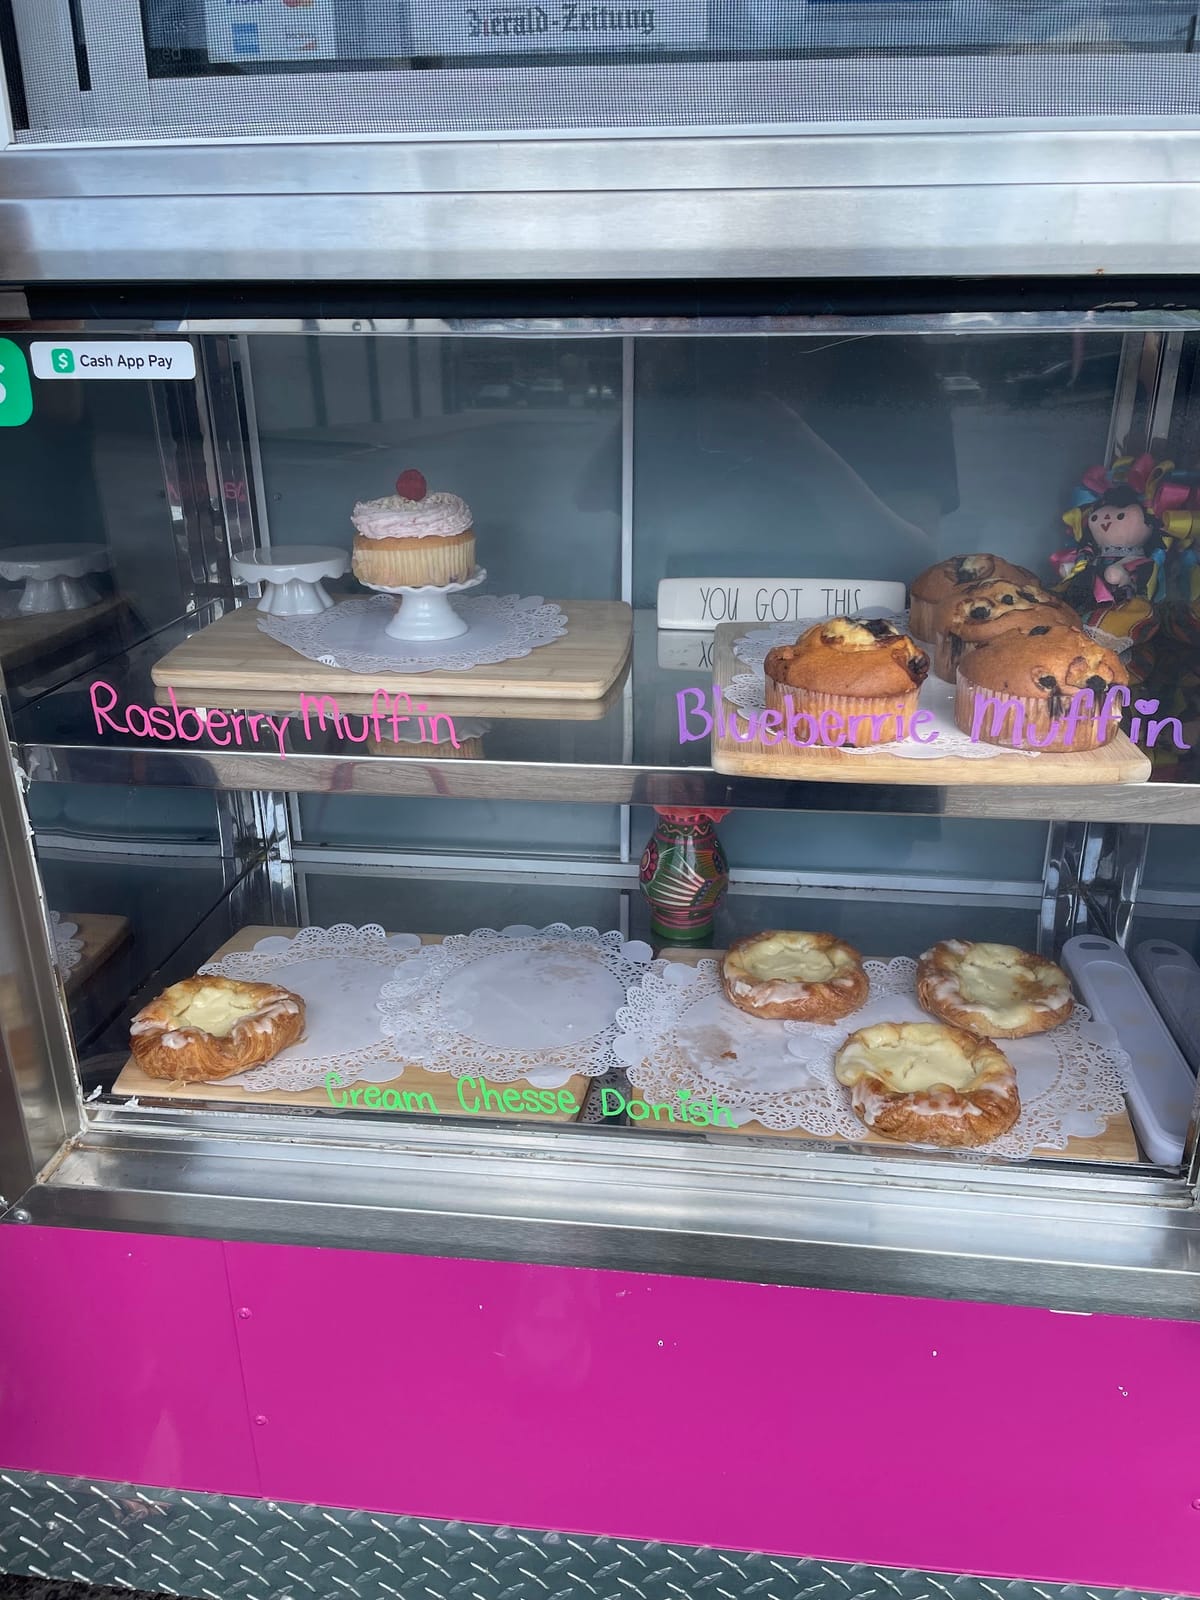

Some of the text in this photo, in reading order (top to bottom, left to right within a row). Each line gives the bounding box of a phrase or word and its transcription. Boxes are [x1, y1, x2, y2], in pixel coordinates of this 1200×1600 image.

[465, 3, 655, 37] Herald-Zeitung
[80, 354, 113, 368] Cash
[117, 354, 145, 370] App
[148, 354, 173, 370] Pay
[699, 587, 861, 621] YOU GOT THIS
[90, 681, 461, 760] Rasberry Muffin
[676, 685, 1191, 749] Blueberrie Muffin
[325, 1072, 439, 1115] Cream
[457, 1076, 580, 1115] Chesse
